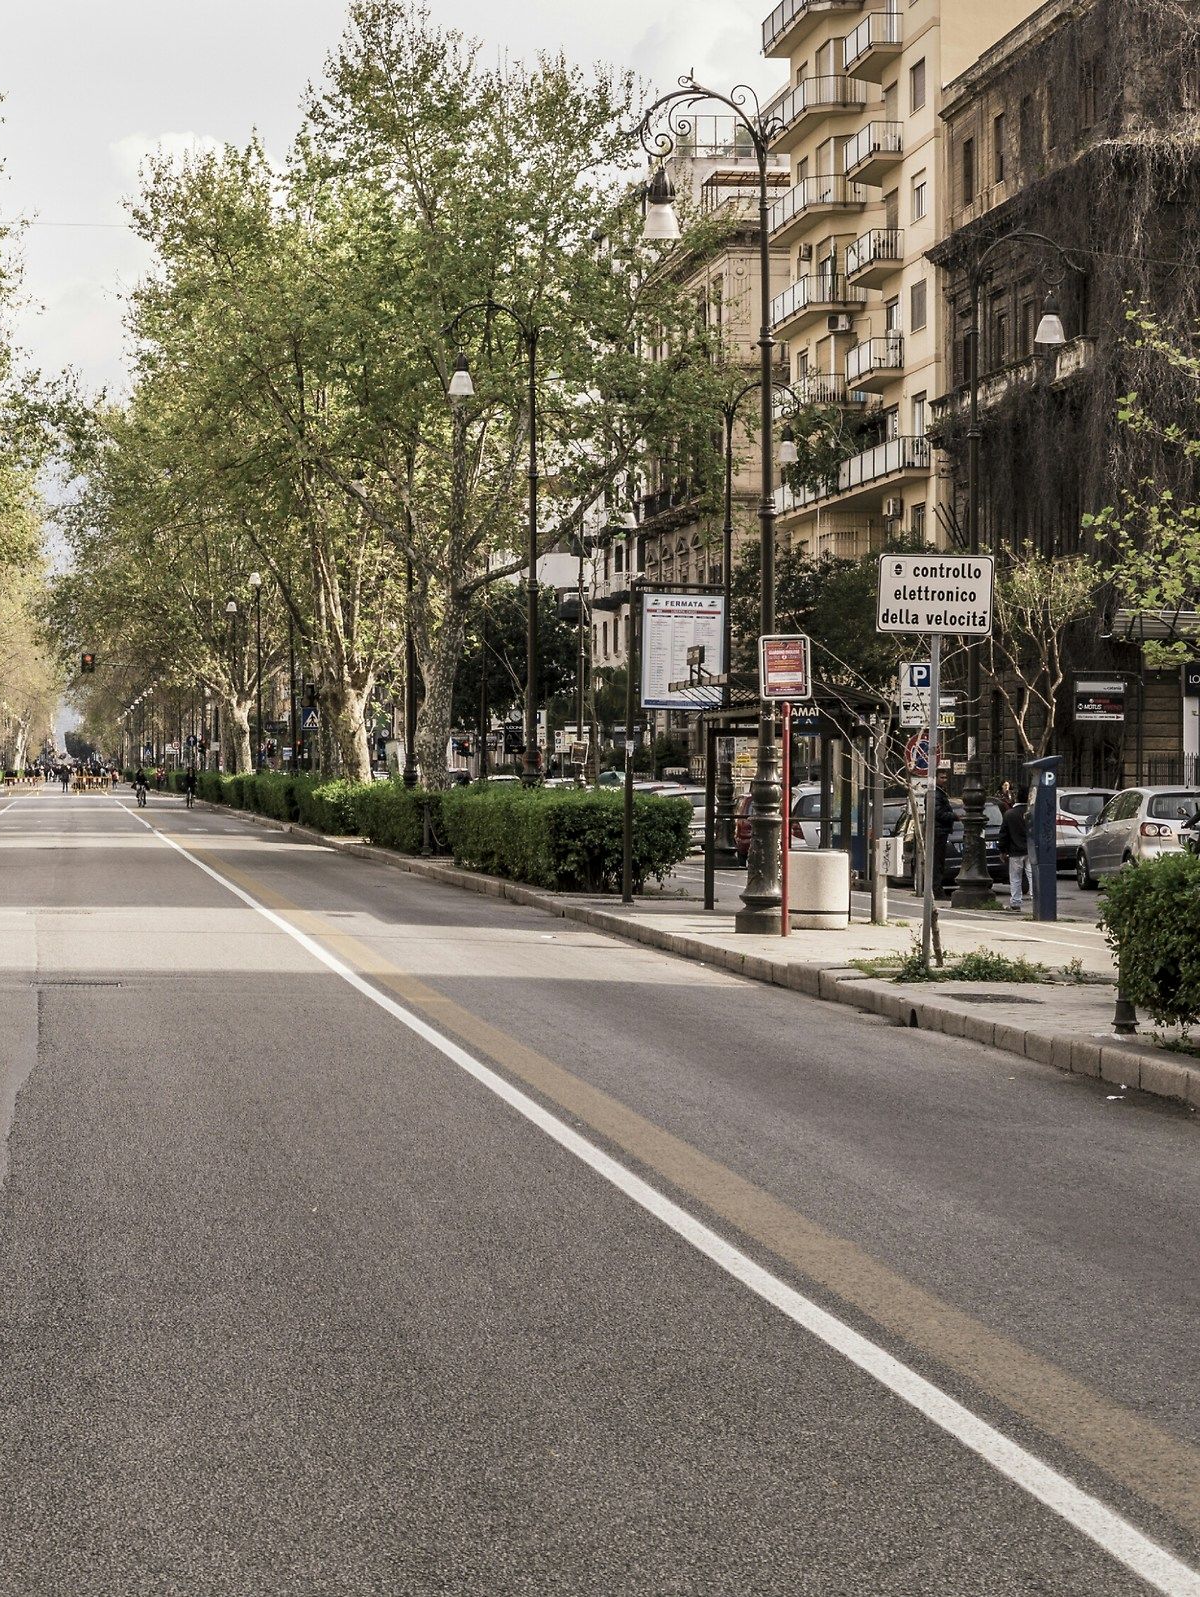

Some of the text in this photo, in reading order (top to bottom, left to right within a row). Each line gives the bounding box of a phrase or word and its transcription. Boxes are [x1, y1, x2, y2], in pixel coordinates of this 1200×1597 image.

[913, 563, 982, 579] controllo
[894, 585, 977, 602] elettronico
[665, 600, 704, 608] FERMATA
[882, 609, 919, 625] della
[912, 666, 928, 686] P
[791, 707, 820, 717] AMAT
[1045, 771, 1055, 786] P
